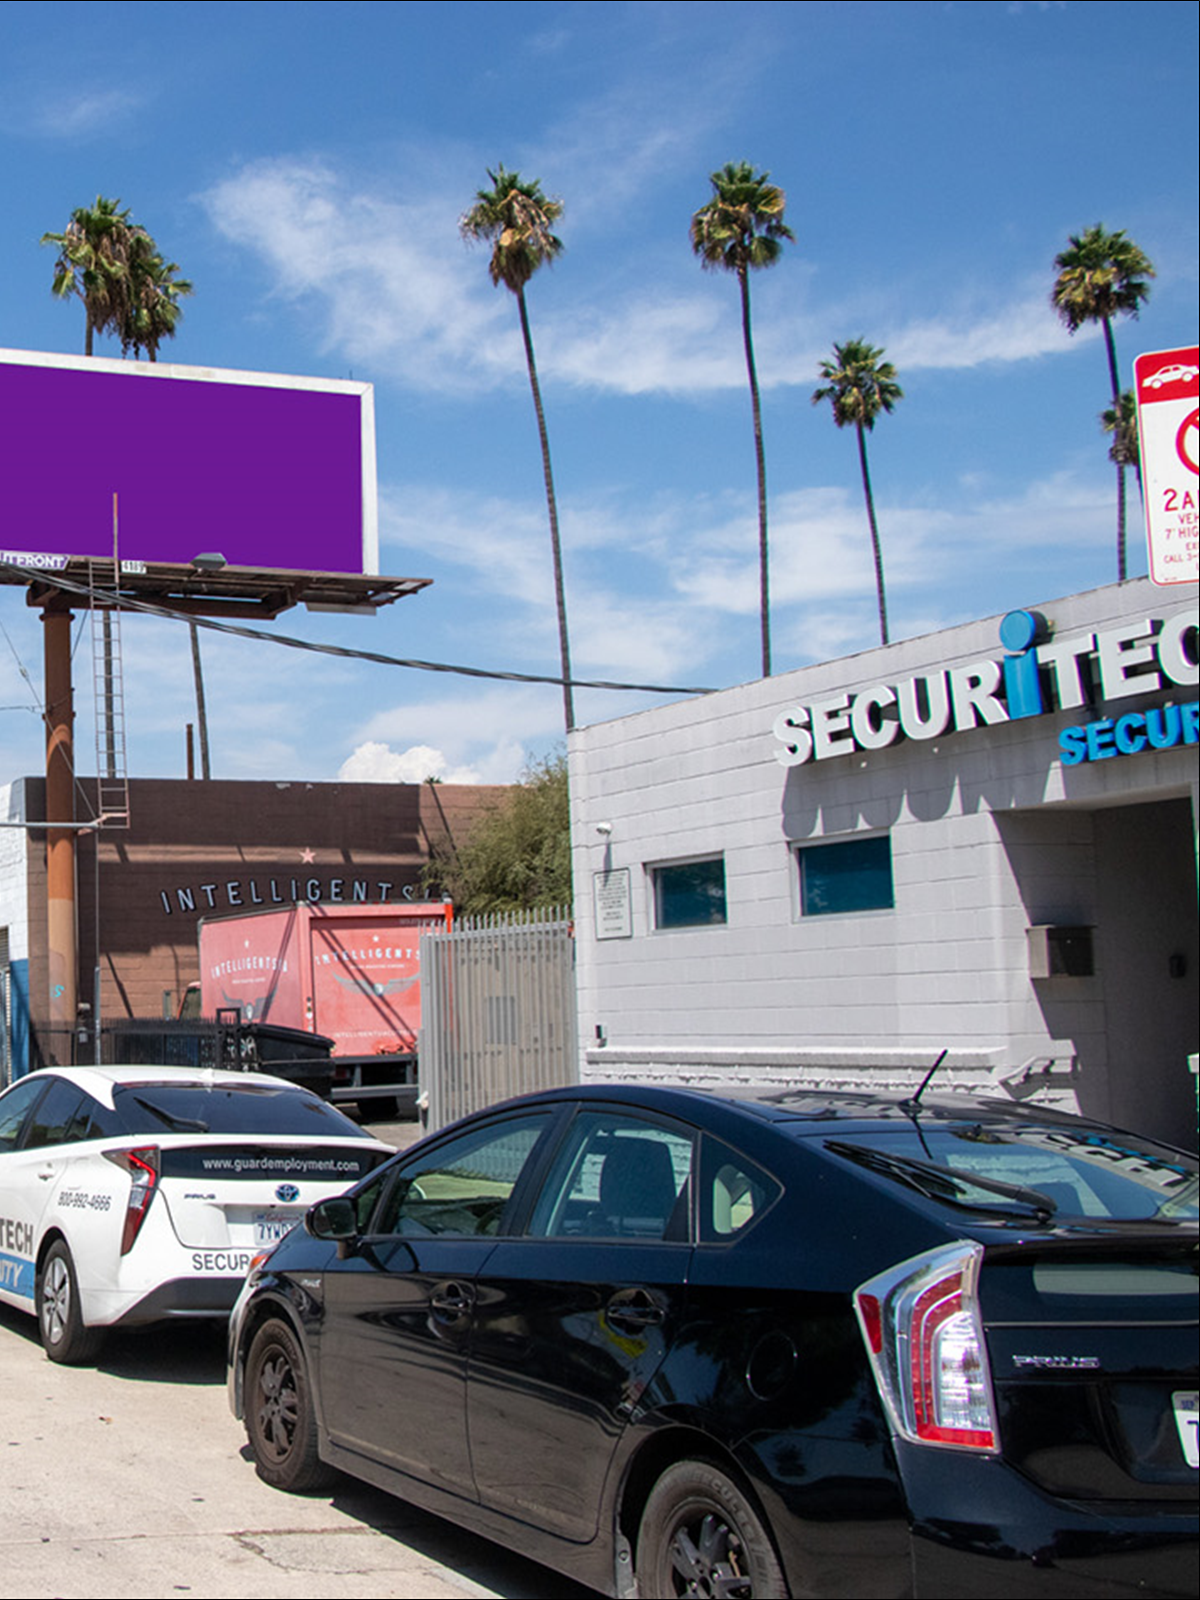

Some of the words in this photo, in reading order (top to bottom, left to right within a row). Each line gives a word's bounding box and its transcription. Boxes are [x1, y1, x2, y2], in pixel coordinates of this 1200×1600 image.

[1163, 488, 1198, 512] 2A
[203, 1157, 360, 1172] www.guardemployment.com
[58, 1191, 112, 1211] 800-992-4666
[258, 1223, 295, 1239] 7YWD
[1012, 1355, 1100, 1369] PRIUS
